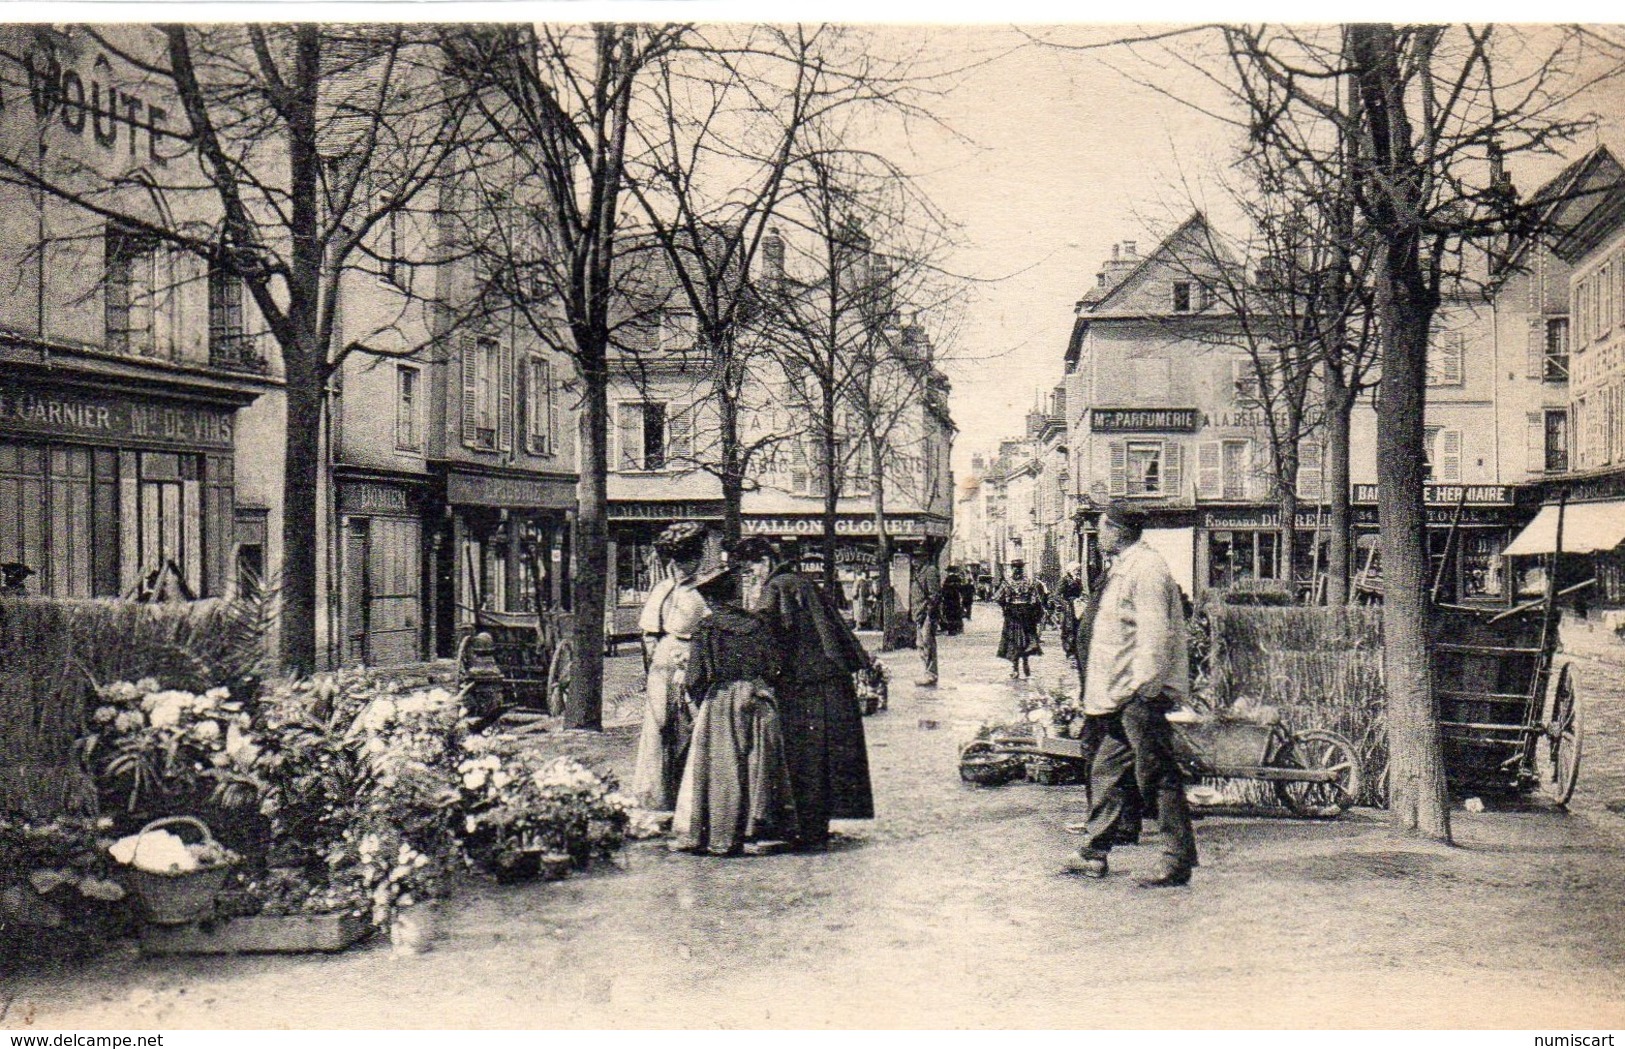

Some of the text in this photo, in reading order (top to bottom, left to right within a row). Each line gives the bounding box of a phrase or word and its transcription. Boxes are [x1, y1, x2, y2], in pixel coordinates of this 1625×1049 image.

[164, 408, 187, 439] DE
[1116, 412, 1192, 427] PARFUMERIE
[1436, 486, 1505, 502] HERNIAIRE
[744, 519, 823, 533] VALLON
